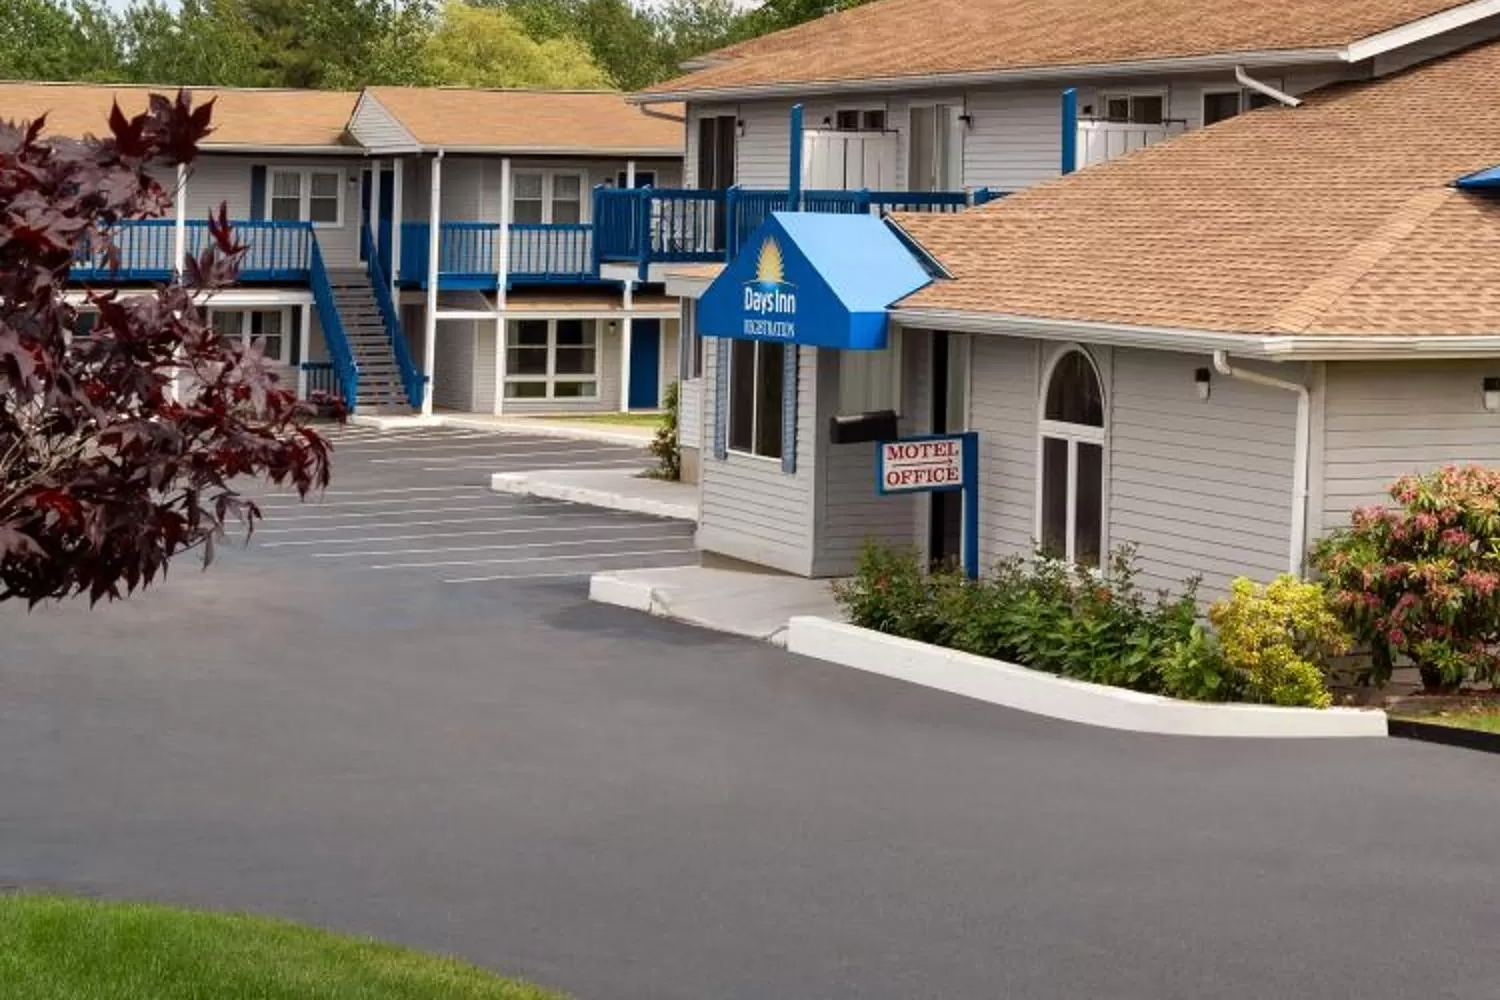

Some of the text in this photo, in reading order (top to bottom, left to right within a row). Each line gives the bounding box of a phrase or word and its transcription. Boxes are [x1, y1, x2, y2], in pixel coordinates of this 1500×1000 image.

[744, 286, 796, 315] Days Inn
[887, 442, 960, 460] MOTEL
[887, 467, 960, 486] OFFICE
